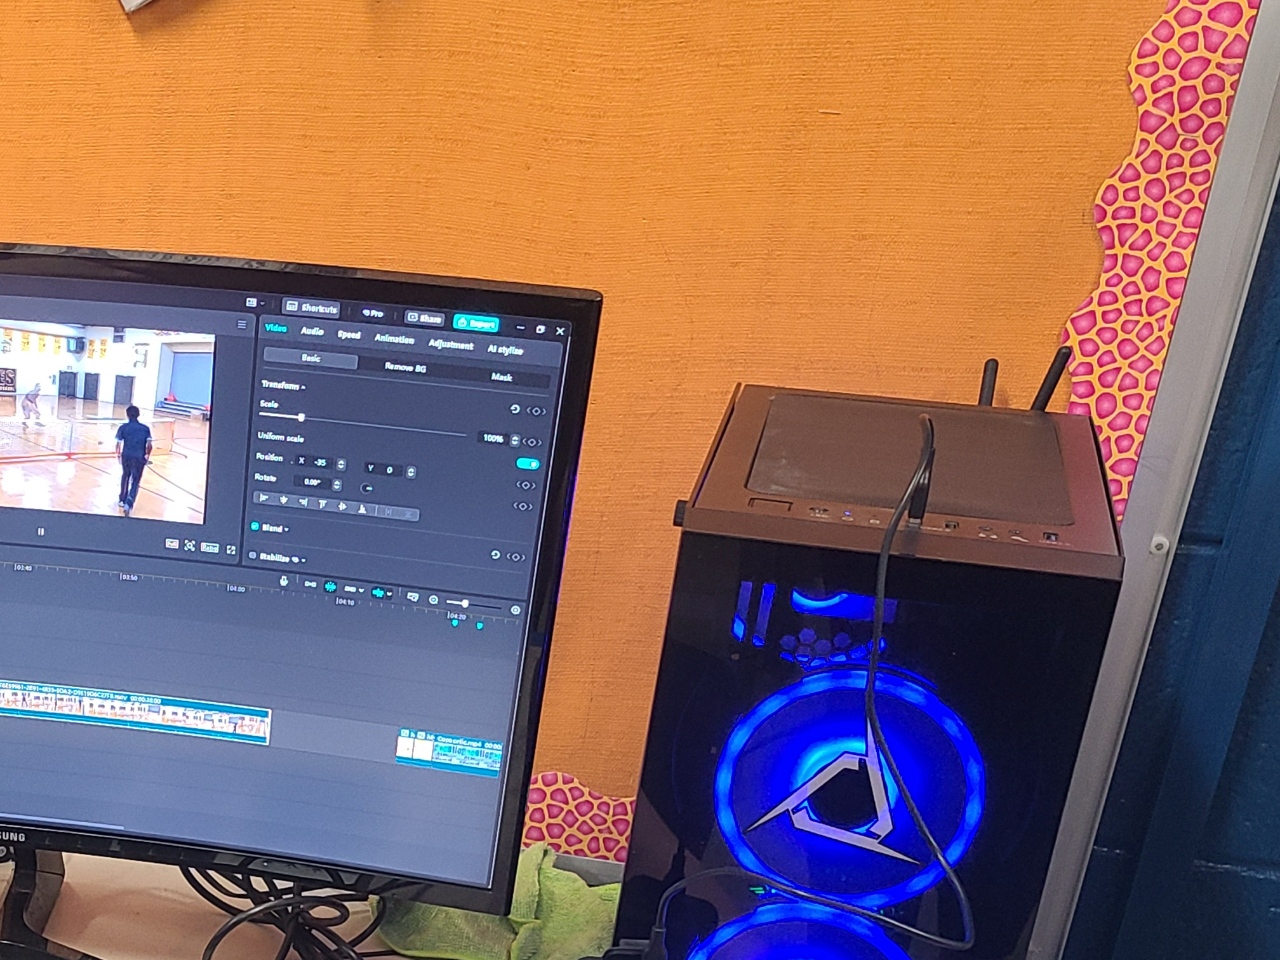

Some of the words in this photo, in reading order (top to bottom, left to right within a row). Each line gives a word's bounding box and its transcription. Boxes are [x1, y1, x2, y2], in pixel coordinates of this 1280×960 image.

[301, 303, 337, 315] Shortcuts
[370, 309, 384, 318] Pro
[420, 314, 442, 324] Share
[265, 323, 287, 334] Video
[301, 327, 324, 337] Audio
[338, 330, 361, 341] Speed
[374, 334, 415, 346] Animation
[428, 338, 474, 352] Adjustment
[487, 343, 497, 354] AI
[497, 345, 524, 357] stylize
[301, 354, 321, 363] Basic
[385, 362, 414, 373] Remove
[415, 365, 427, 374] BG
[491, 372, 513, 383] Mask
[261, 379, 299, 391] Transform
[260, 400, 279, 409] Scale
[258, 431, 285, 442] Uniform
[286, 434, 305, 444] scale
[483, 433, 504, 444] 100%
[256, 452, 283, 463] Position
[298, 457, 305, 465] X
[368, 464, 374, 472] Y
[254, 473, 277, 483] Rotate
[262, 523, 283, 534] Blend
[260, 552, 290, 564] Stabilize
